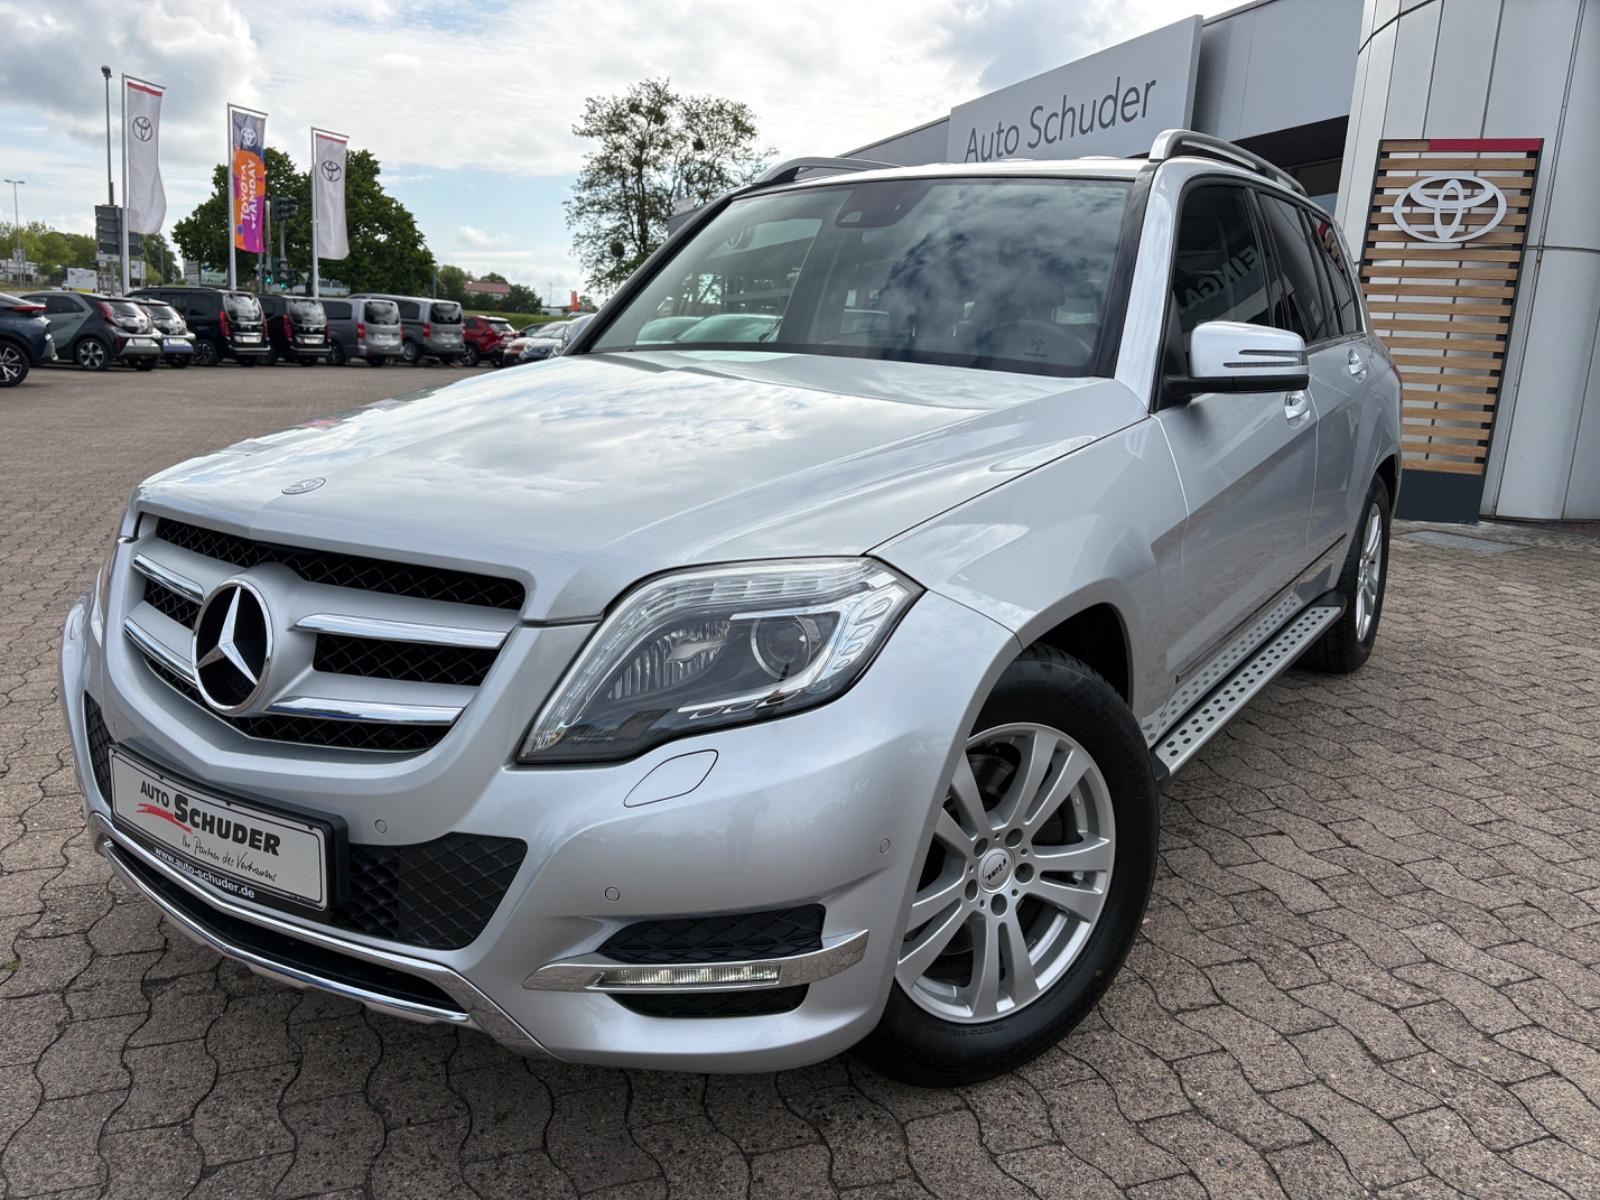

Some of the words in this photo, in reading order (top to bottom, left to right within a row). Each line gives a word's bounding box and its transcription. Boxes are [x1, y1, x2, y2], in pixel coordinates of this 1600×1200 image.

[964, 121, 1020, 163] Auto
[1027, 76, 1157, 149] Schuder
[240, 165, 251, 221] TOYOTA
[140, 780, 170, 808] AUTO
[174, 794, 281, 857] SCHUDER
[154, 847, 255, 899] www.auto-schuder.de
